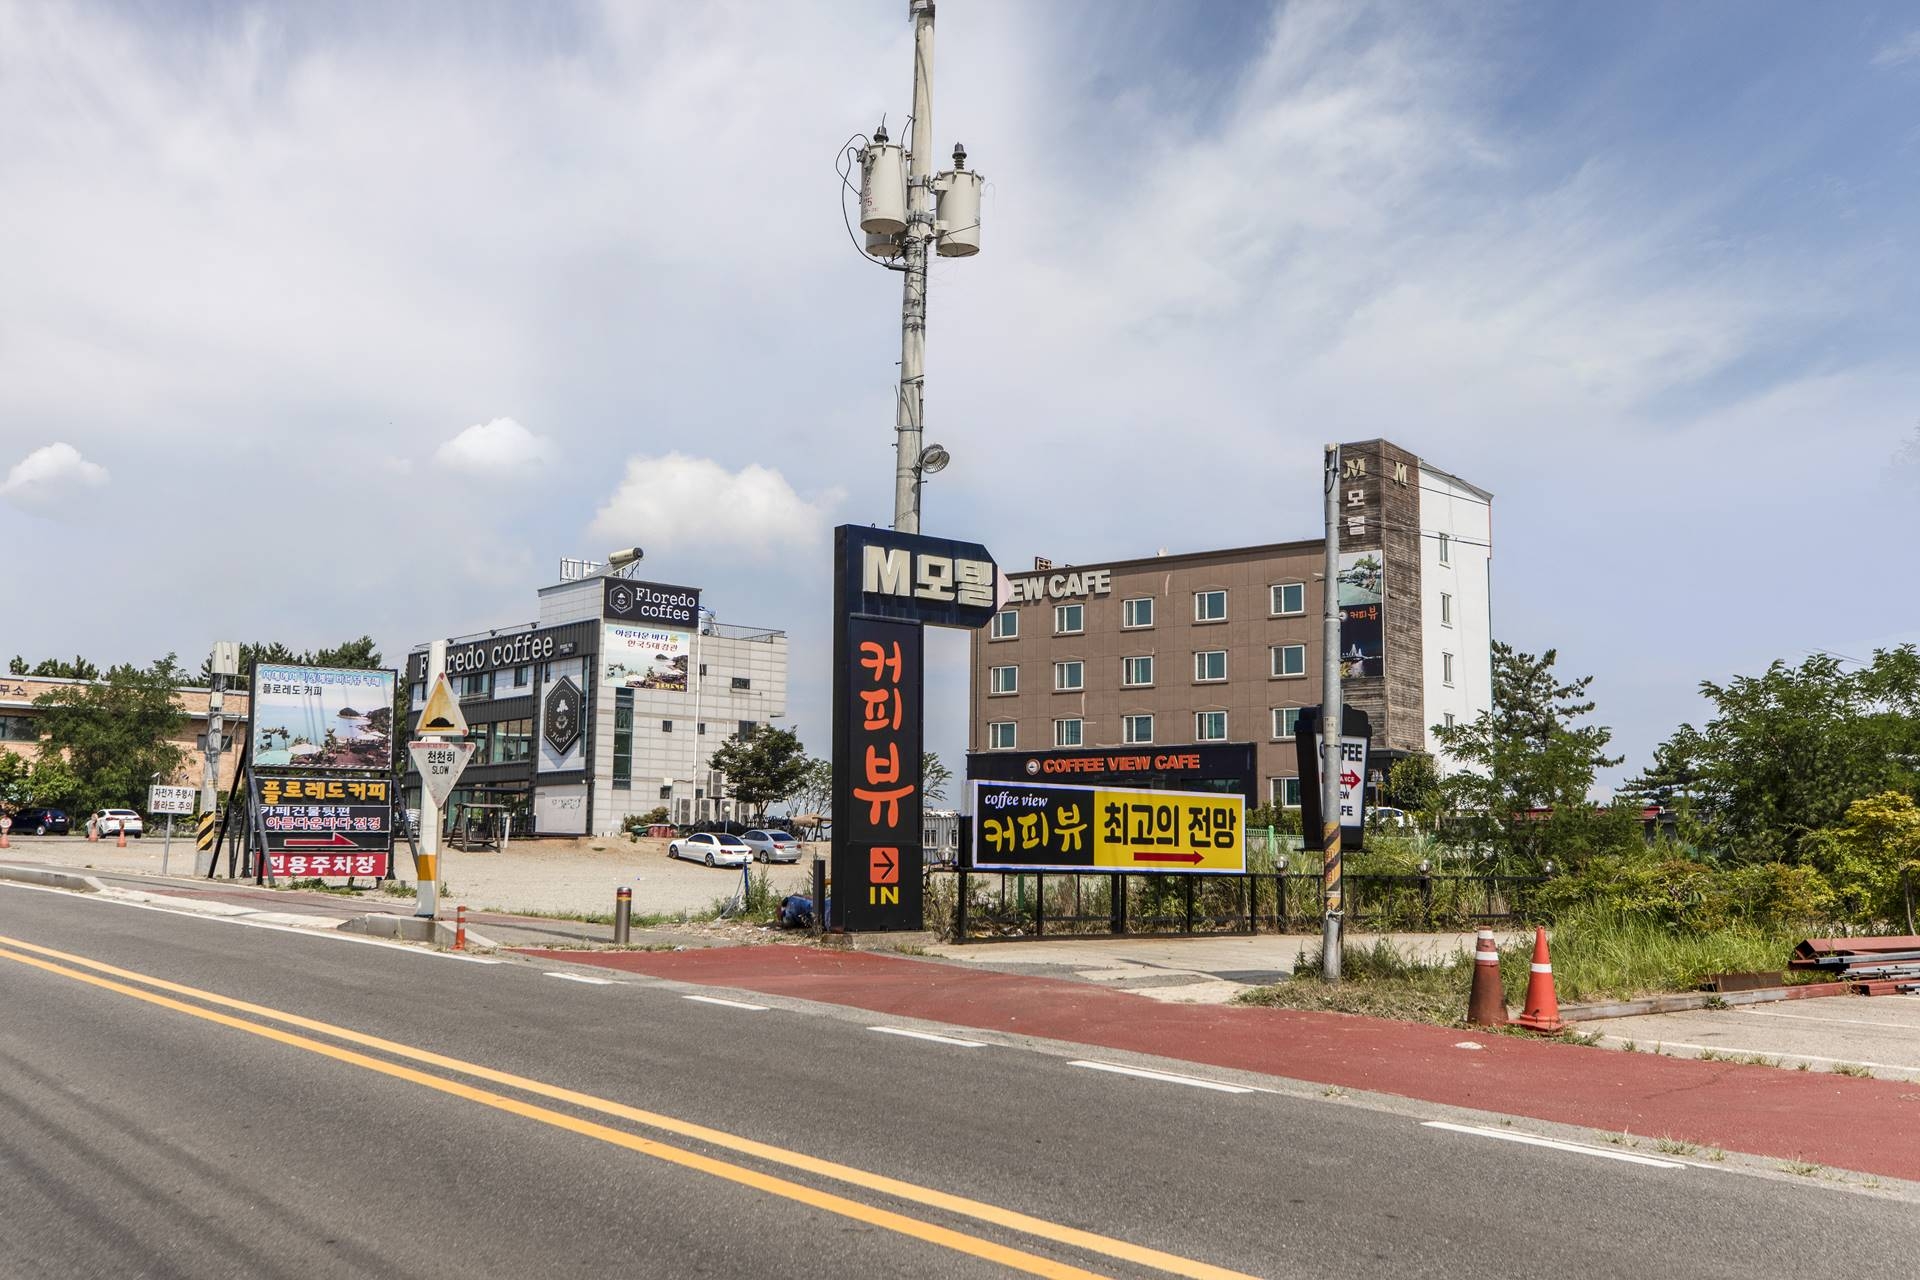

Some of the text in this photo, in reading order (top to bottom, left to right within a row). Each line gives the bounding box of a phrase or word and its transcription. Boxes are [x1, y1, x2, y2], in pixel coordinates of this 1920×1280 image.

[1393, 461, 1408, 487] M
[1009, 569, 1111, 602] EW CAFE
[636, 587, 696, 607] Floredo
[641, 605, 690, 620] coffee
[1350, 607, 1378, 621] 커피뷰
[615, 629, 668, 641] 아름다운 바다
[419, 645, 485, 678] Fredo
[491, 634, 553, 665] coffee
[262, 683, 322, 696] 플로레도 커피
[853, 641, 915, 828] 커피뷰
[427, 751, 455, 764] 천천히
[1043, 754, 1200, 774] COFFEE VIEW CAFE
[432, 765, 449, 775] SLOW
[154, 788, 193, 799] 자전거 주행시
[984, 792, 1048, 809] coffee view
[153, 801, 192, 811] 볼라드 주의
[984, 803, 1088, 852] 커피뷰
[1104, 801, 1236, 849] 최고의 전망
[270, 855, 376, 873] 전용주차장
[869, 886, 899, 905] IN
